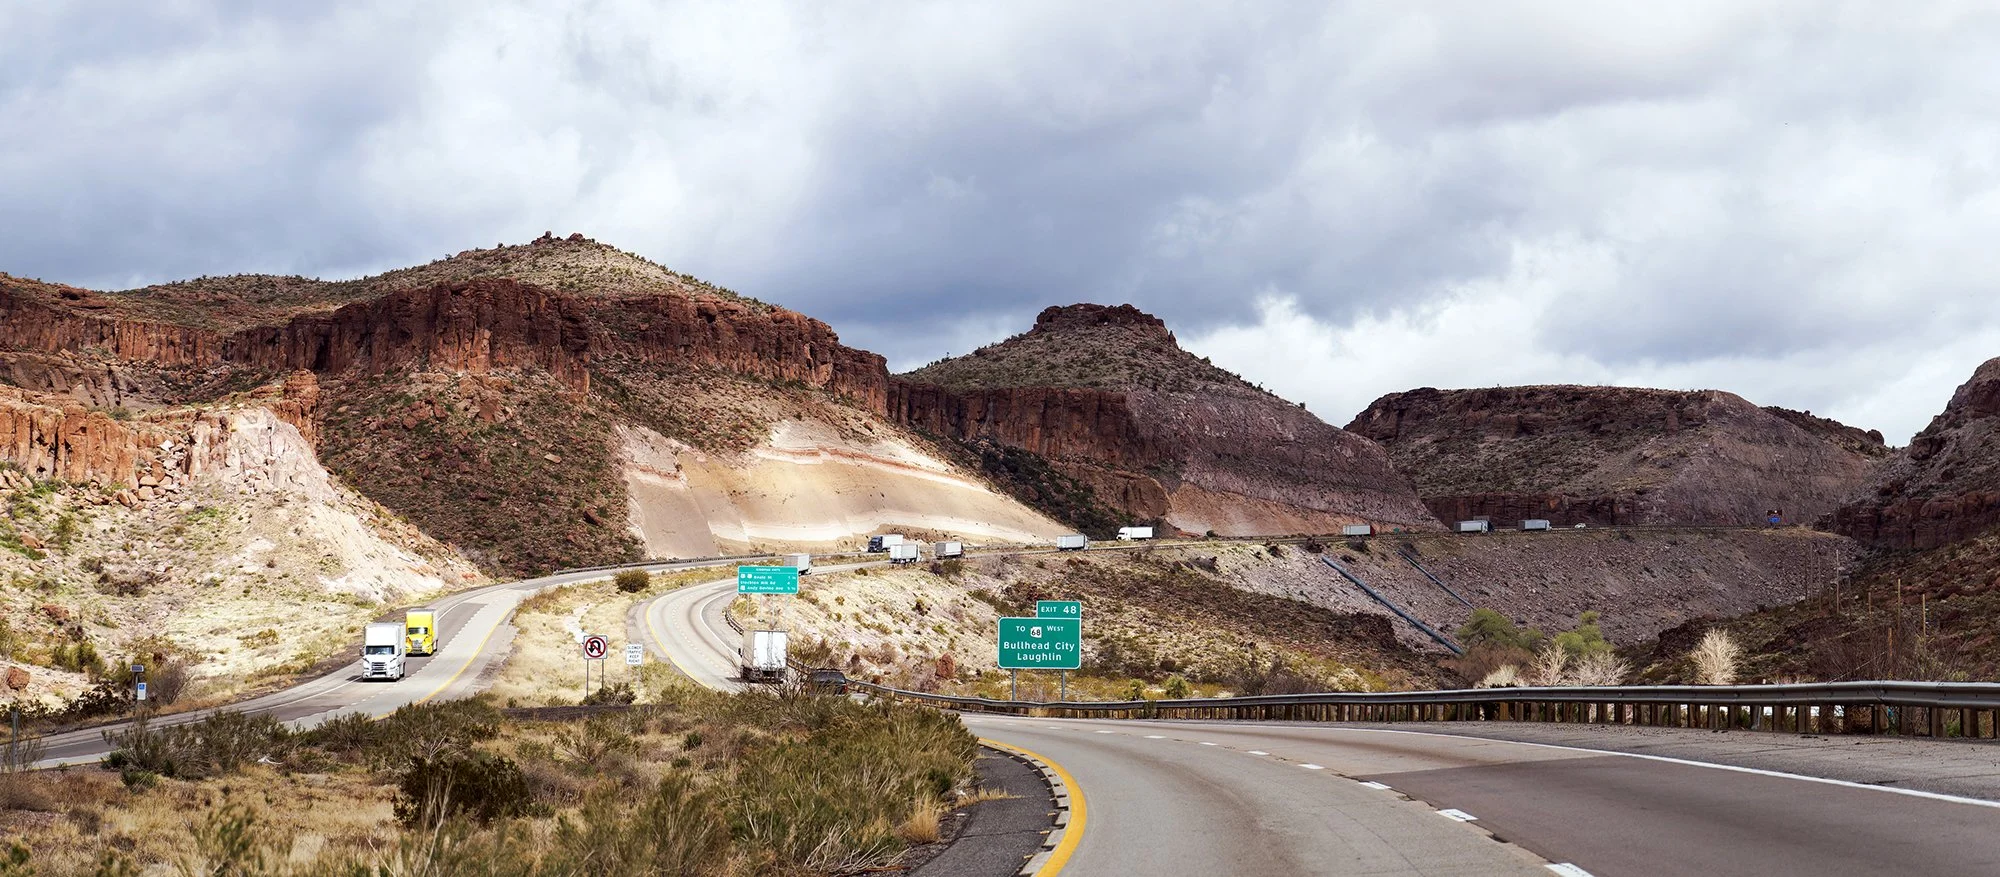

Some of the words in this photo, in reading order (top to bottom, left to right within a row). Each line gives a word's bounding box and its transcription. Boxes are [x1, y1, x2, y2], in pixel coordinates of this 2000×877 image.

[1063, 606, 1076, 614] 48
[1004, 642, 1049, 650] Bullhead
[1055, 642, 1075, 652] City
[1017, 653, 1062, 662] Laughlin
